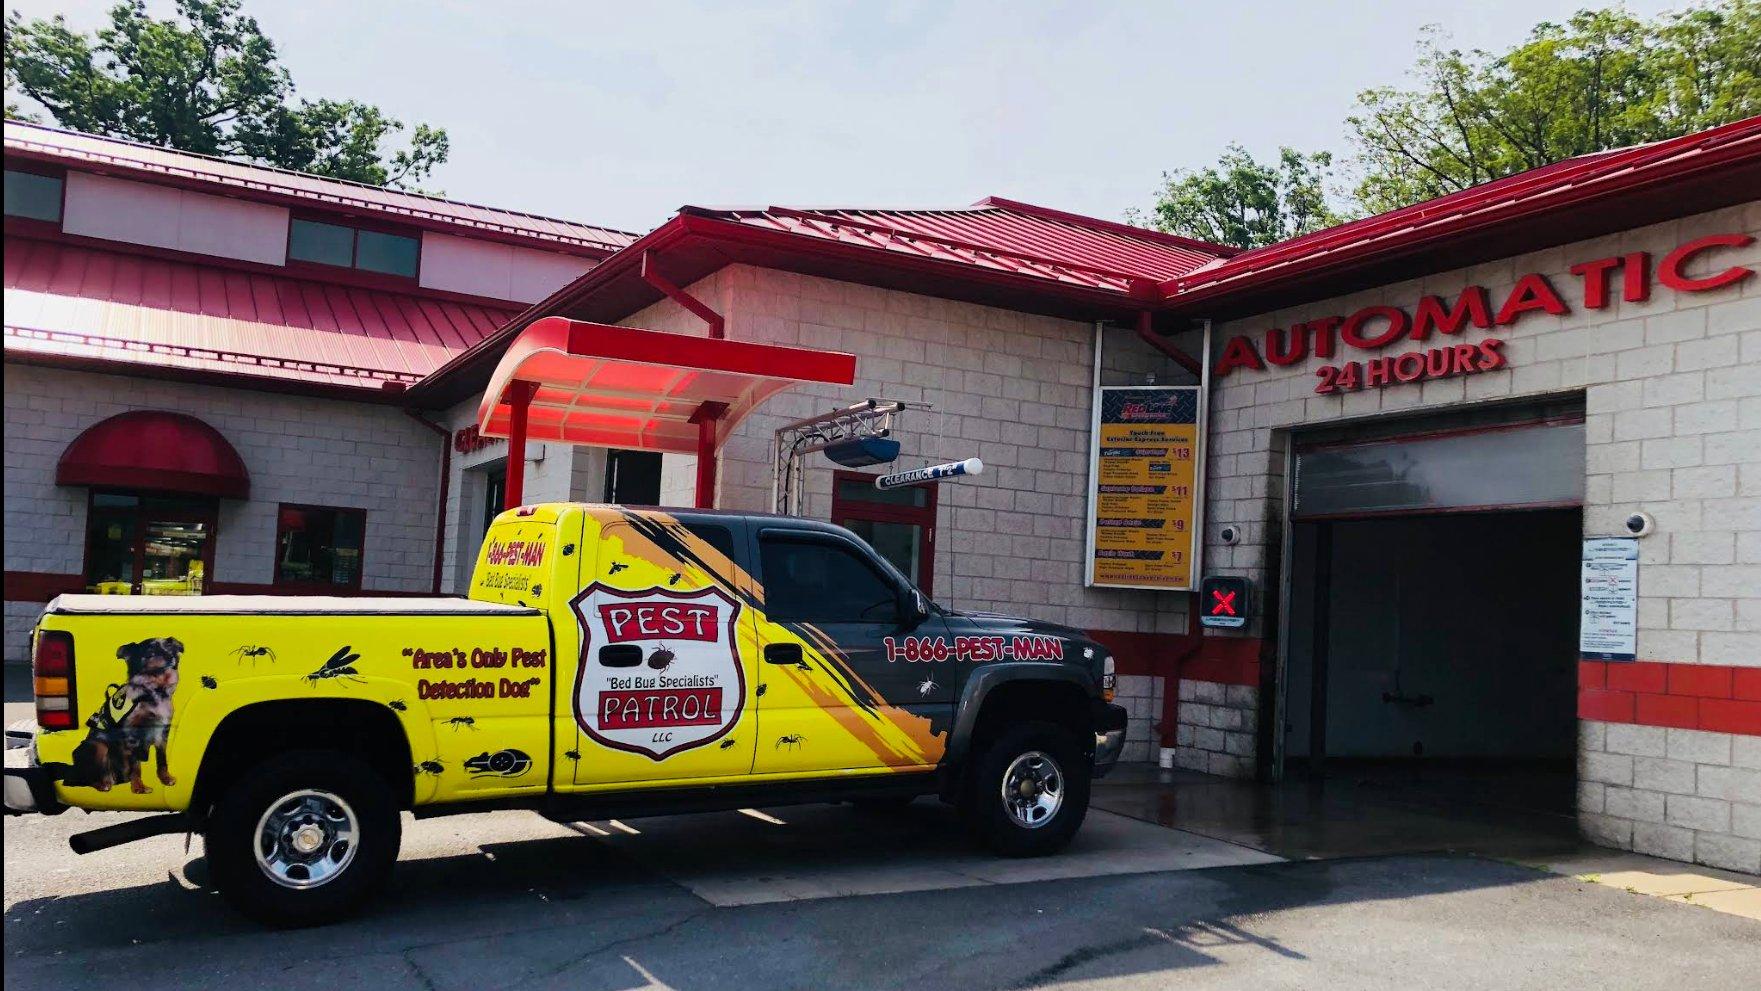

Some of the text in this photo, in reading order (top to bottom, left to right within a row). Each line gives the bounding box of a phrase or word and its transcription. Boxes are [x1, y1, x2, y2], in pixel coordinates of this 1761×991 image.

[1214, 232, 1757, 377] AUTOMATIC
[1314, 338, 1508, 396] 24 HOURS
[1172, 447, 1190, 459] $13
[885, 469, 934, 486] CLEARANCE
[1172, 485, 1188, 496] $11
[1172, 519, 1185, 531] $9
[1171, 551, 1182, 562] $7
[608, 606, 710, 637] PEST
[402, 647, 547, 670] "Area's Only Pest
[883, 636, 1064, 663] 1-866-PEST-MAN
[417, 677, 541, 700] Detection Dog"
[606, 673, 719, 690] "Bed Bug Specialists"
[603, 693, 716, 724] PATROL
[651, 732, 673, 743] LLC
